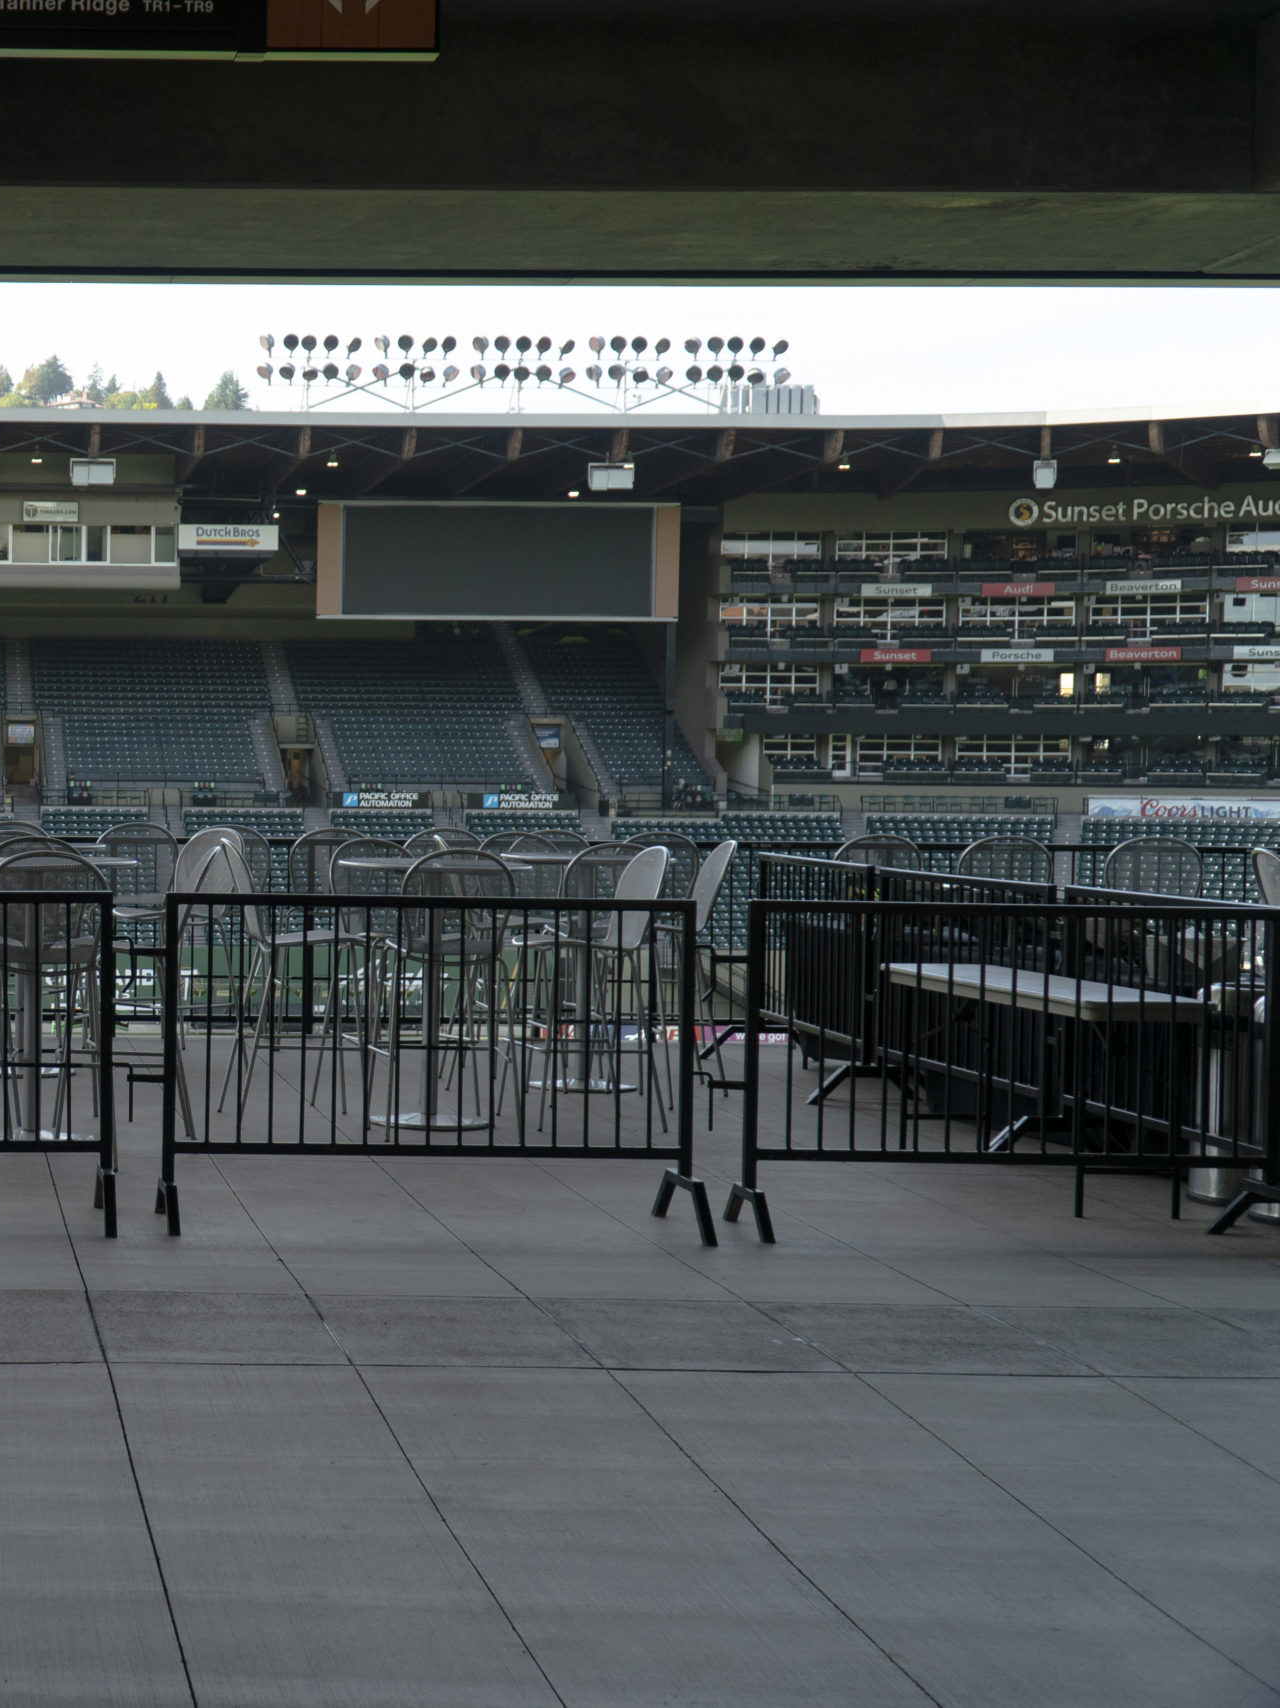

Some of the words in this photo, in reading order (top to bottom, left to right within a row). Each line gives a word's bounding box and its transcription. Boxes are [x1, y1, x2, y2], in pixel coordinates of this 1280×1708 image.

[143, 0, 214, 13] TR1-TR9
[1042, 501, 1126, 523] Sunset
[1133, 496, 1235, 520] Porsche
[875, 585, 918, 596] Sunset
[1004, 584, 1033, 594] Audi
[1110, 581, 1177, 592] Beaverton
[873, 650, 917, 660] Sunset
[992, 650, 1042, 660] Porsche
[1110, 649, 1177, 660] Beaverton
[359, 792, 389, 800] PACIFIC
[499, 794, 529, 802] PACIFIC
[531, 794, 559, 802] OFFICE
[359, 800, 412, 808] AUTOMATION
[1140, 798, 1198, 818] Coors
[1200, 806, 1252, 818] LIGHT
